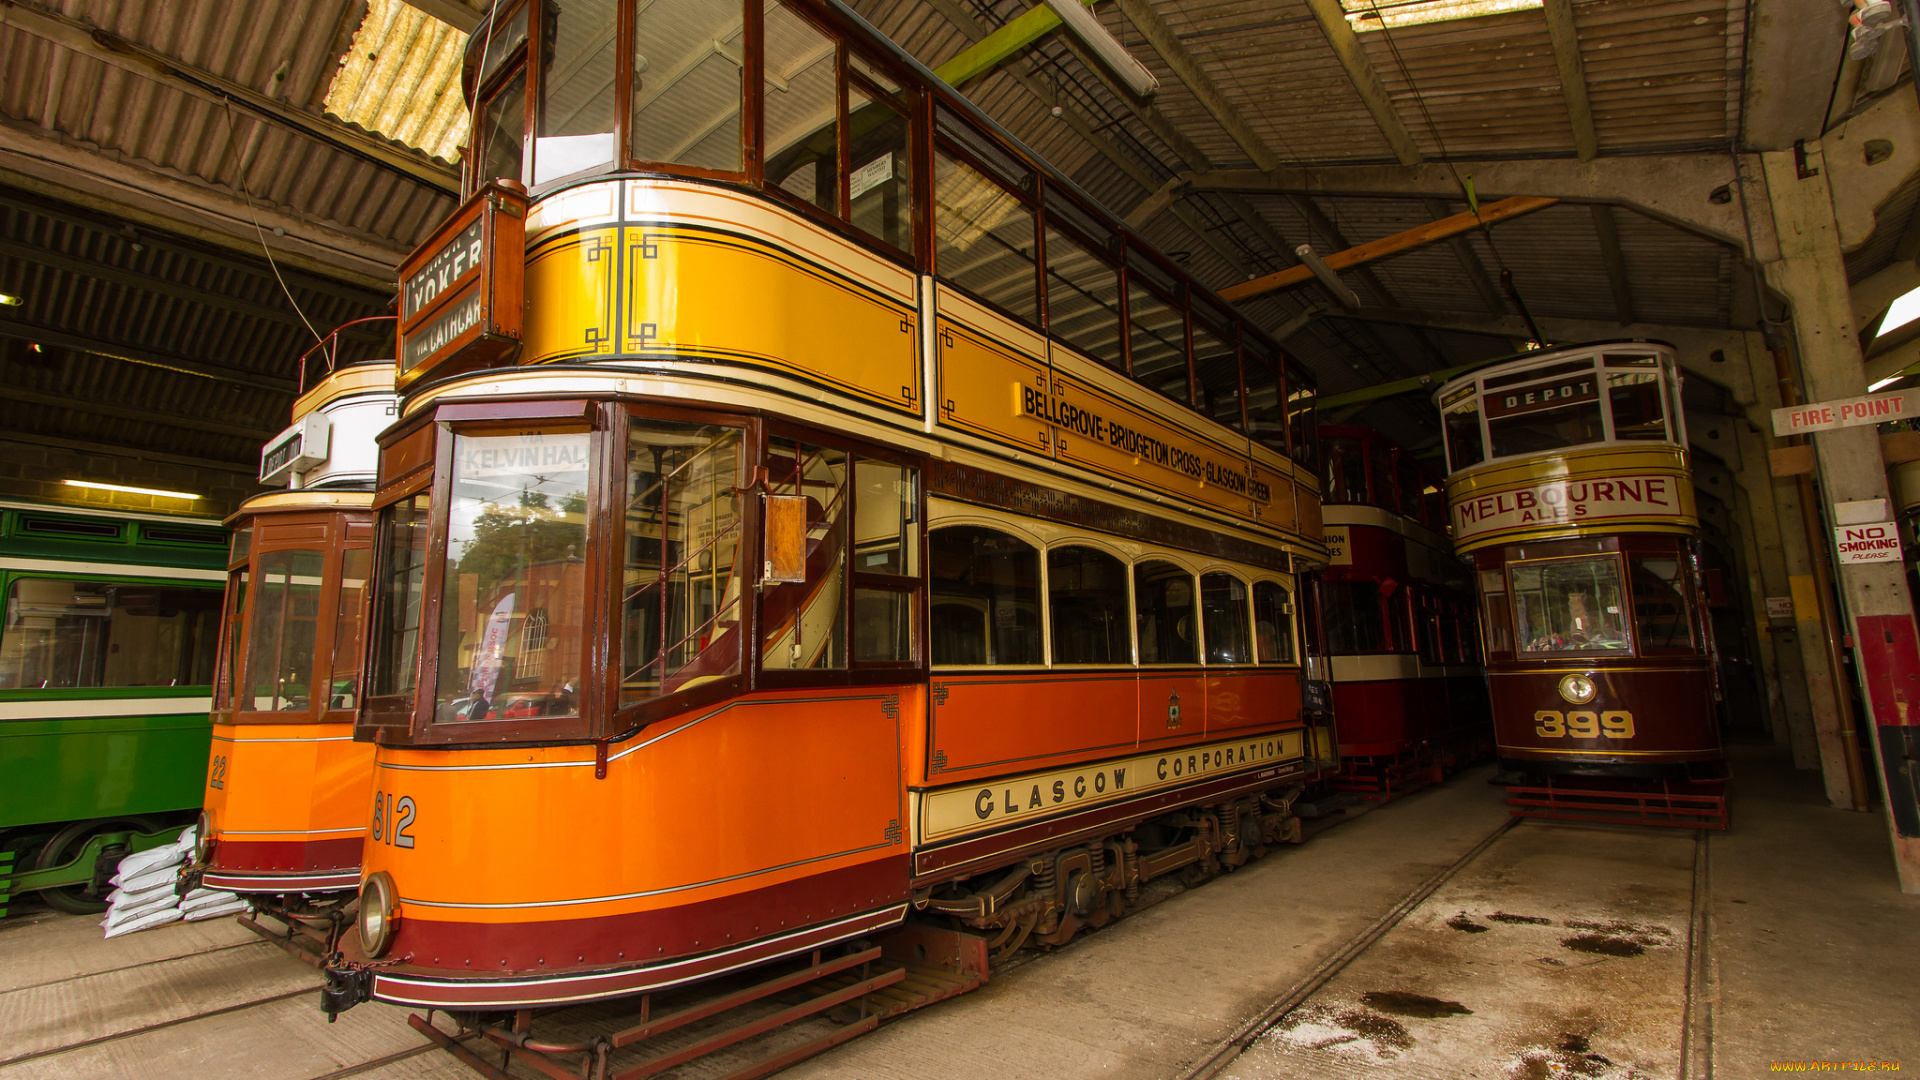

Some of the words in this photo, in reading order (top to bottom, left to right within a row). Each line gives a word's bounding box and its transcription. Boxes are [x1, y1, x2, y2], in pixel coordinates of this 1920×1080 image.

[416, 342, 427, 356] VIA
[1506, 381, 1591, 408] DEPOT
[1791, 408, 1833, 428] FIRE
[1840, 397, 1903, 420] POINT
[519, 430, 544, 444] VIA
[466, 447, 539, 469] KELVIN
[1248, 478, 1270, 502] GREEN
[1460, 479, 1669, 529] MELBOURNE
[1521, 503, 1587, 523] ALES
[1838, 538, 1898, 553] SMOKING
[1845, 527, 1885, 541] NO
[1852, 551, 1890, 560] PLEASE
[1534, 710, 1636, 738] 399
[210, 755, 226, 790] 22
[975, 768, 1126, 820] GLASGOW
[1157, 739, 1283, 780] CORPORATION
[373, 791, 416, 849] 812
